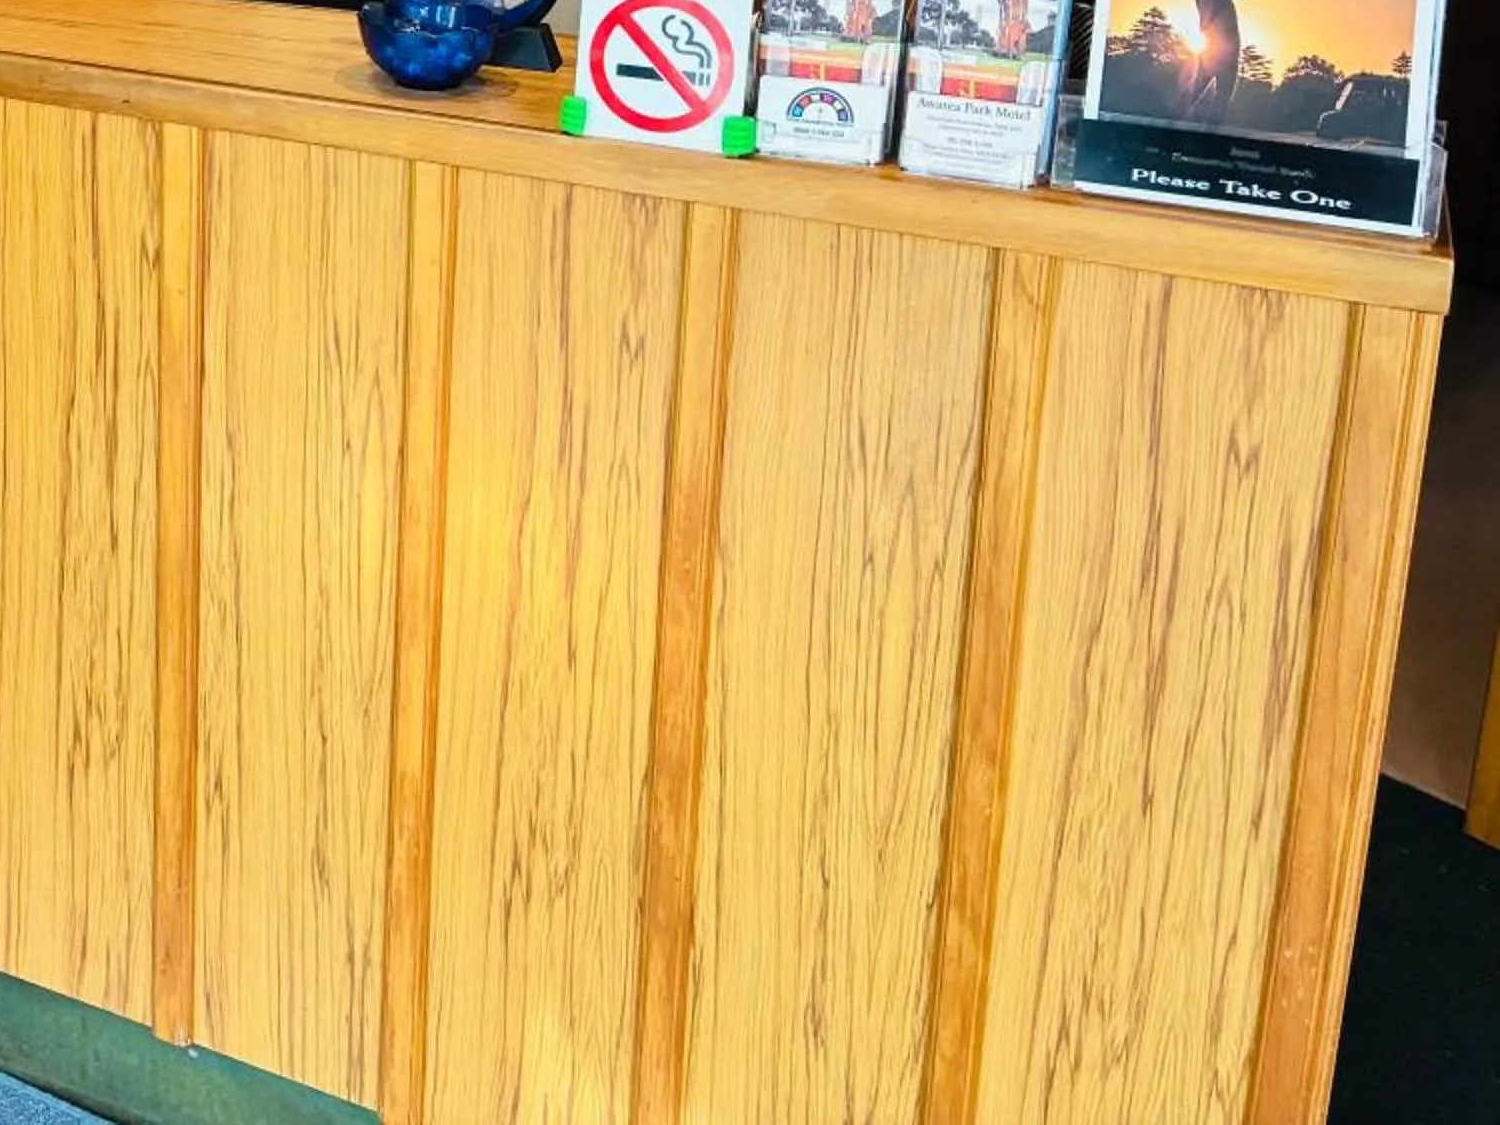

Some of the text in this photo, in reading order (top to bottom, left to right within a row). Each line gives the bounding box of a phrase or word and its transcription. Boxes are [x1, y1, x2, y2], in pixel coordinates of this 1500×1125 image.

[964, 102, 991, 115] Park
[996, 106, 1031, 120] Motel
[1131, 167, 1352, 210] Please Take One
